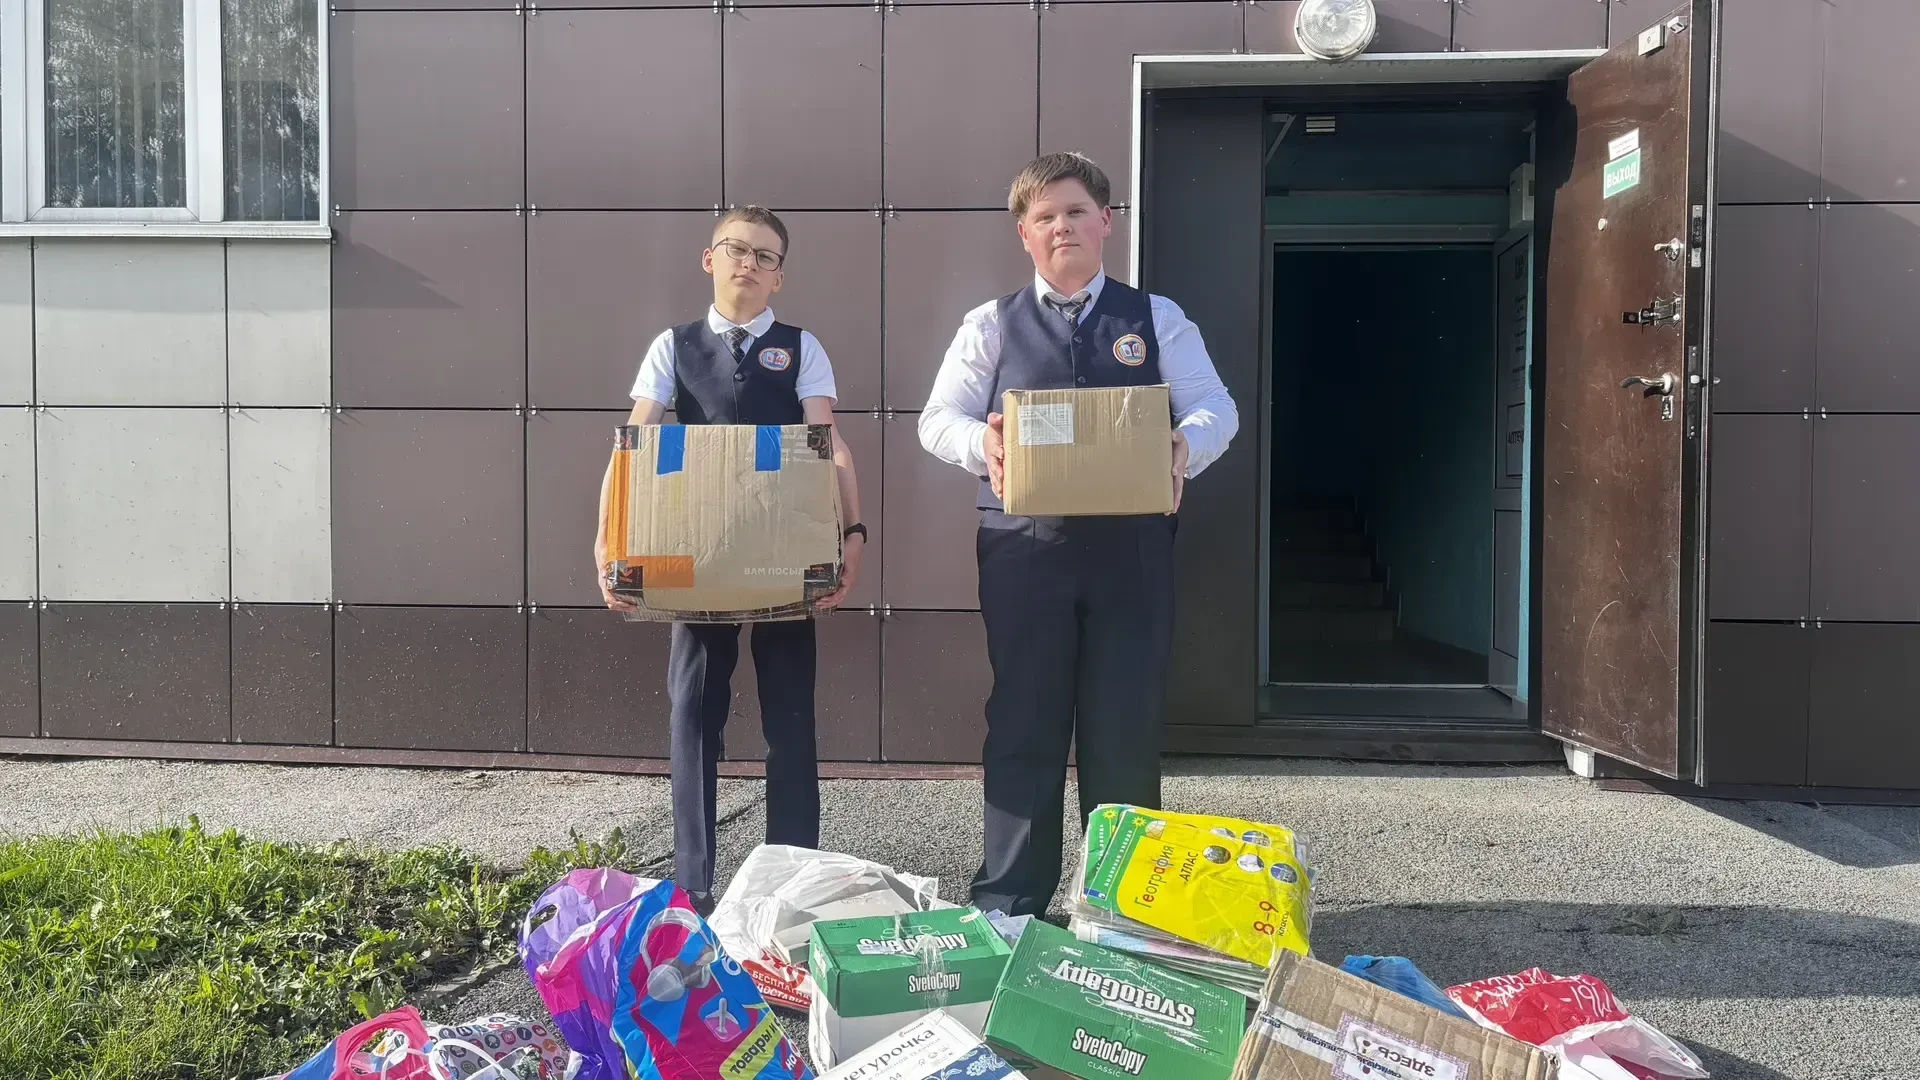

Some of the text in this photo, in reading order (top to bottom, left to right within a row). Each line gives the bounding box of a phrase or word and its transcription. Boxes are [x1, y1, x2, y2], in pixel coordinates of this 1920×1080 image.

[1606, 161, 1637, 189] ВЫХОД
[768, 567, 805, 576] ПОСЫЛ
[1134, 845, 1174, 908] География
[1179, 851, 1199, 882] АТЛАС
[908, 972, 961, 993] SvetoCopy
[1053, 959, 1196, 1027] SvetoCopy
[843, 1029, 935, 1080] егурочка
[1072, 1027, 1148, 1076] SvetoCopy
[1377, 1045, 1436, 1077] ЗДЕСЬ
[1087, 1061, 1121, 1077] CLASSIC
